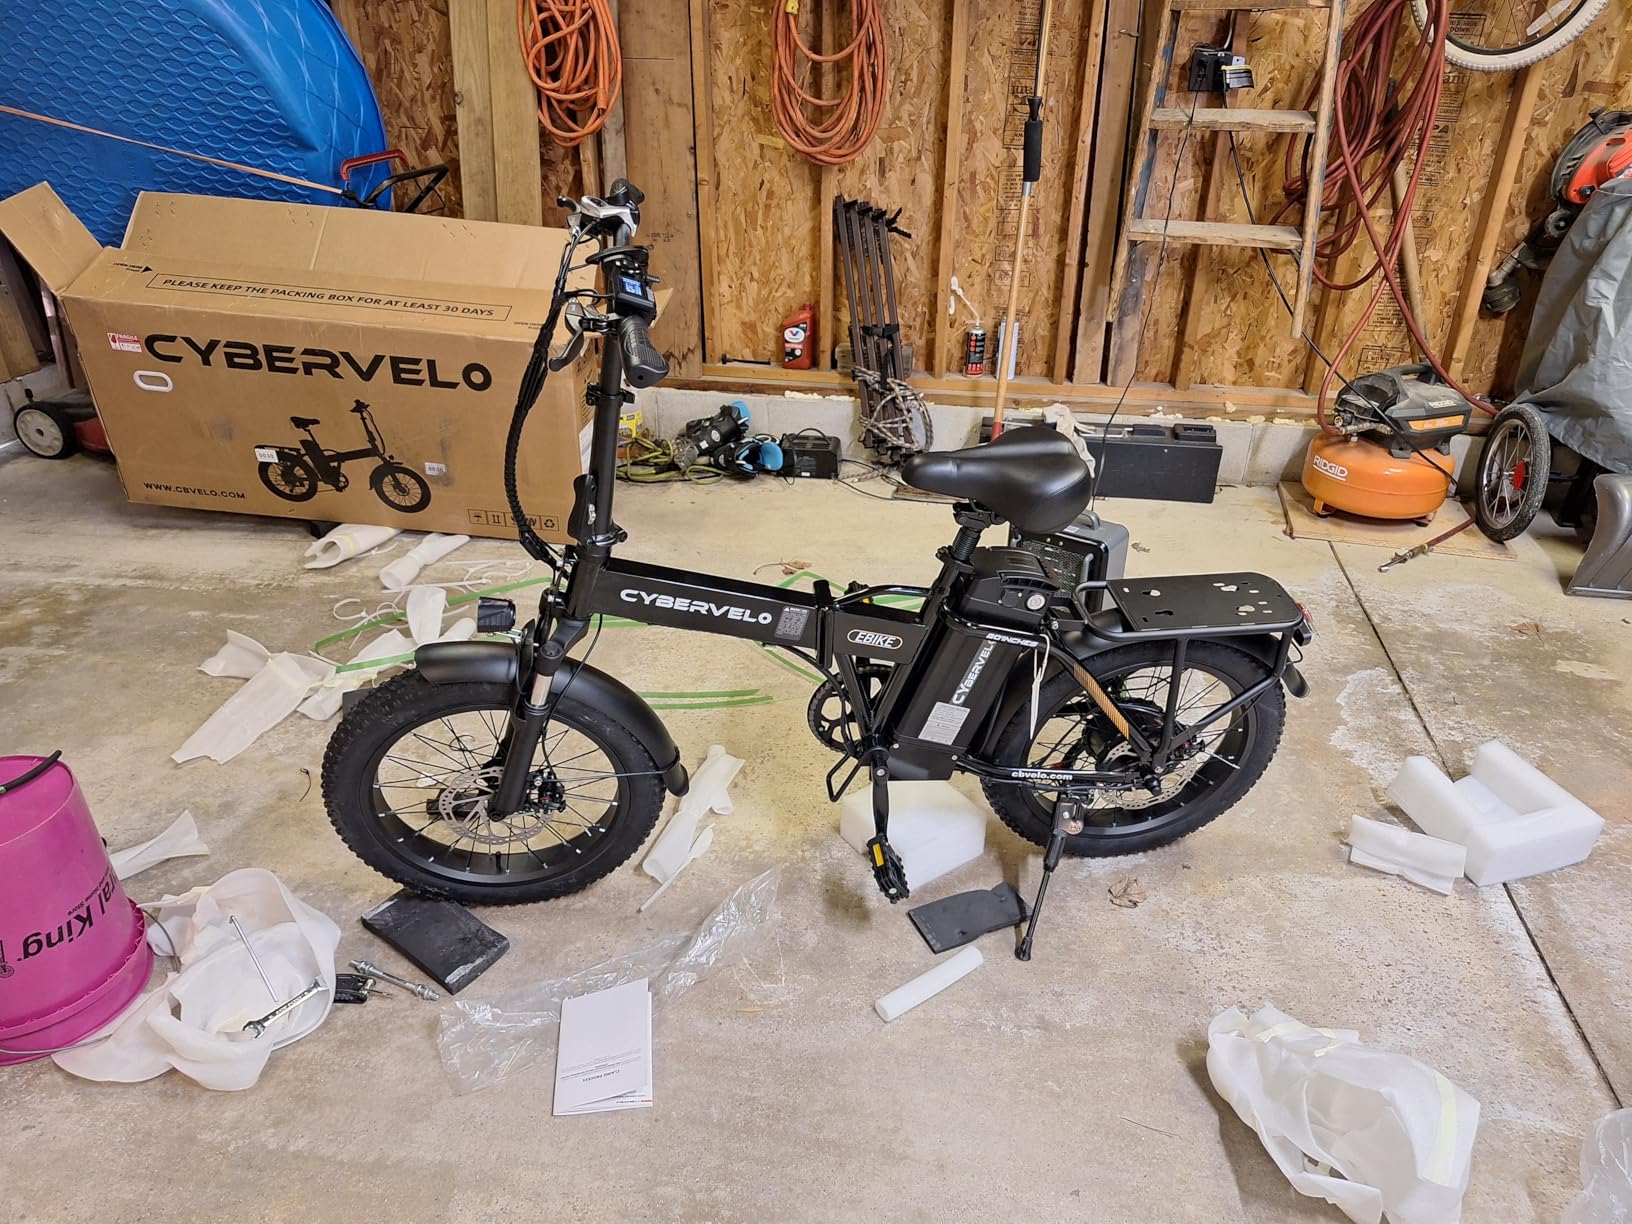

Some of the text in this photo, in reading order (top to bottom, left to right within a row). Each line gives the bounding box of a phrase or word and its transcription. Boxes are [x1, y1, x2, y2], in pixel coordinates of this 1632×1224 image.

[162, 278, 495, 317] PLEASE KEEP THE PACKING BOX FOR AT LEAST 30 DAYS
[116, 333, 139, 341] FRAGILE
[144, 333, 493, 392] CYBERVELO
[1313, 455, 1349, 478] RIDGID
[143, 481, 246, 499] WWW.CBVELO.COM
[619, 588, 773, 625] CYBERVELO
[855, 631, 895, 648] EBIKE
[1011, 770, 1073, 781] cbvelo.com
[67, 901, 85, 916] Store
[22, 904, 94, 961] King
